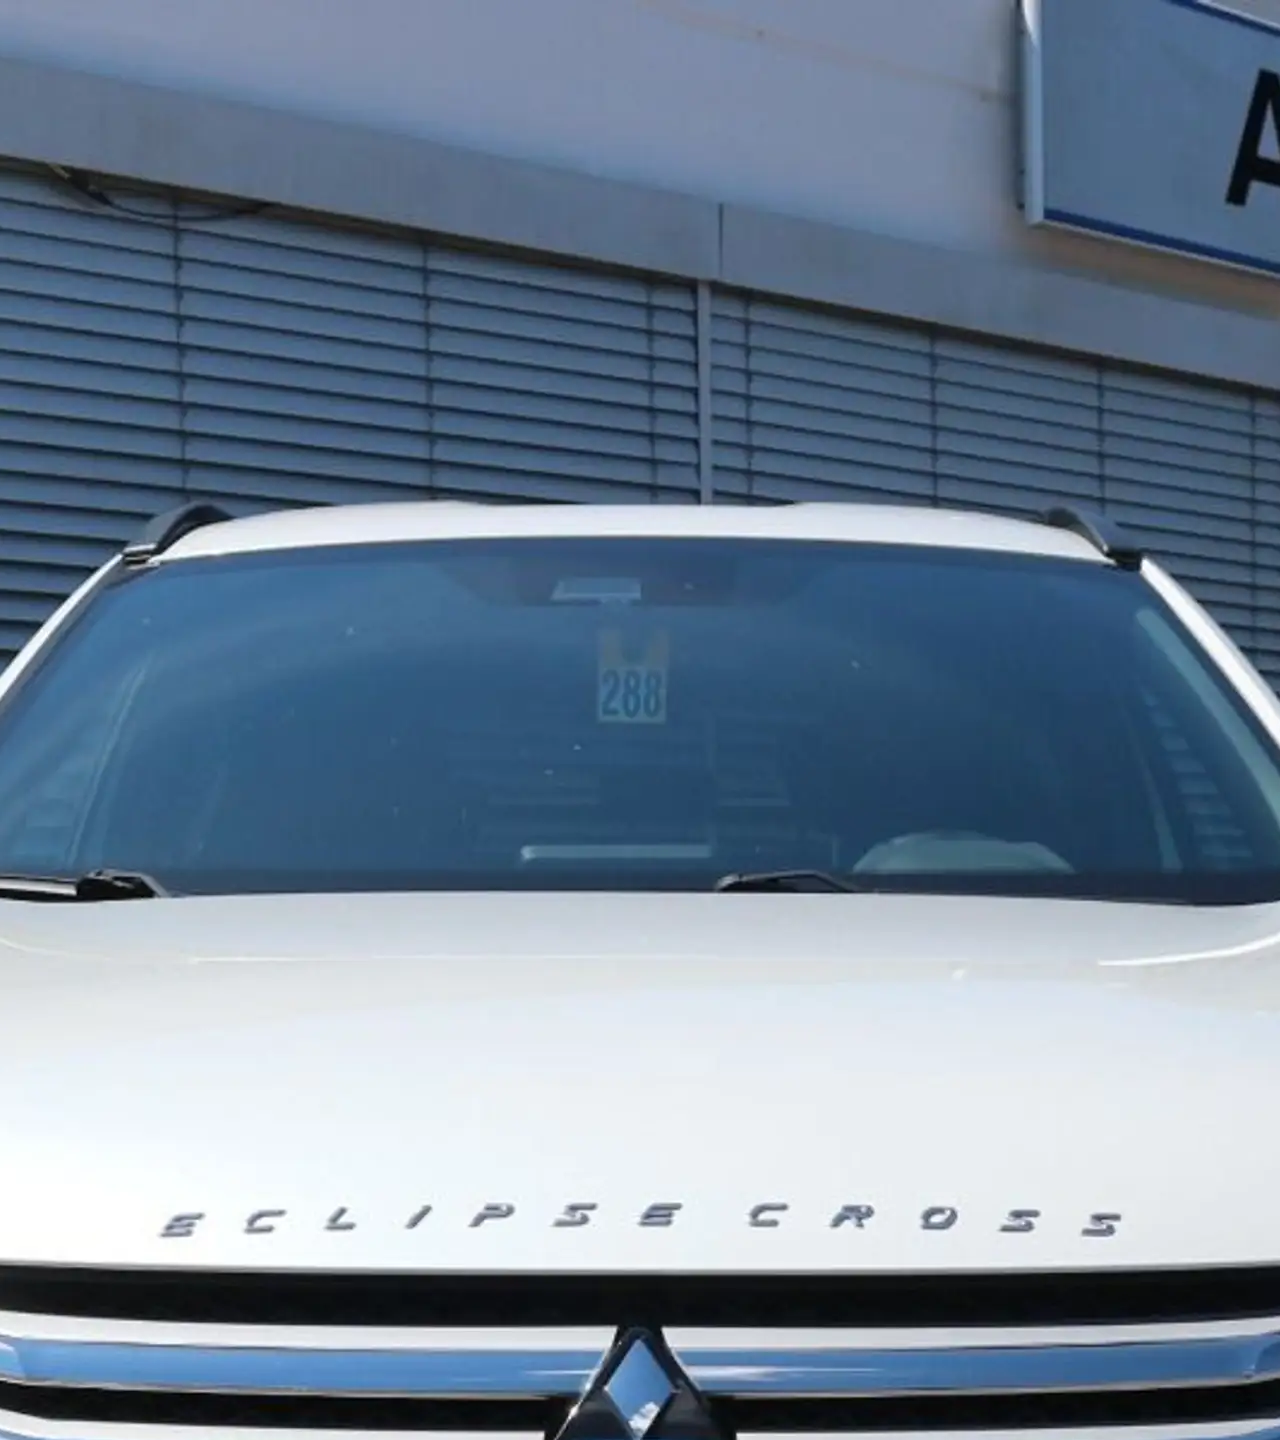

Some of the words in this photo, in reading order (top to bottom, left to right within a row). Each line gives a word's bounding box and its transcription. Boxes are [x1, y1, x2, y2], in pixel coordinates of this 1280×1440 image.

[601, 668, 663, 719] 288
[159, 1202, 683, 1238] ECLIPSE
[748, 1202, 1122, 1238] CROSS
